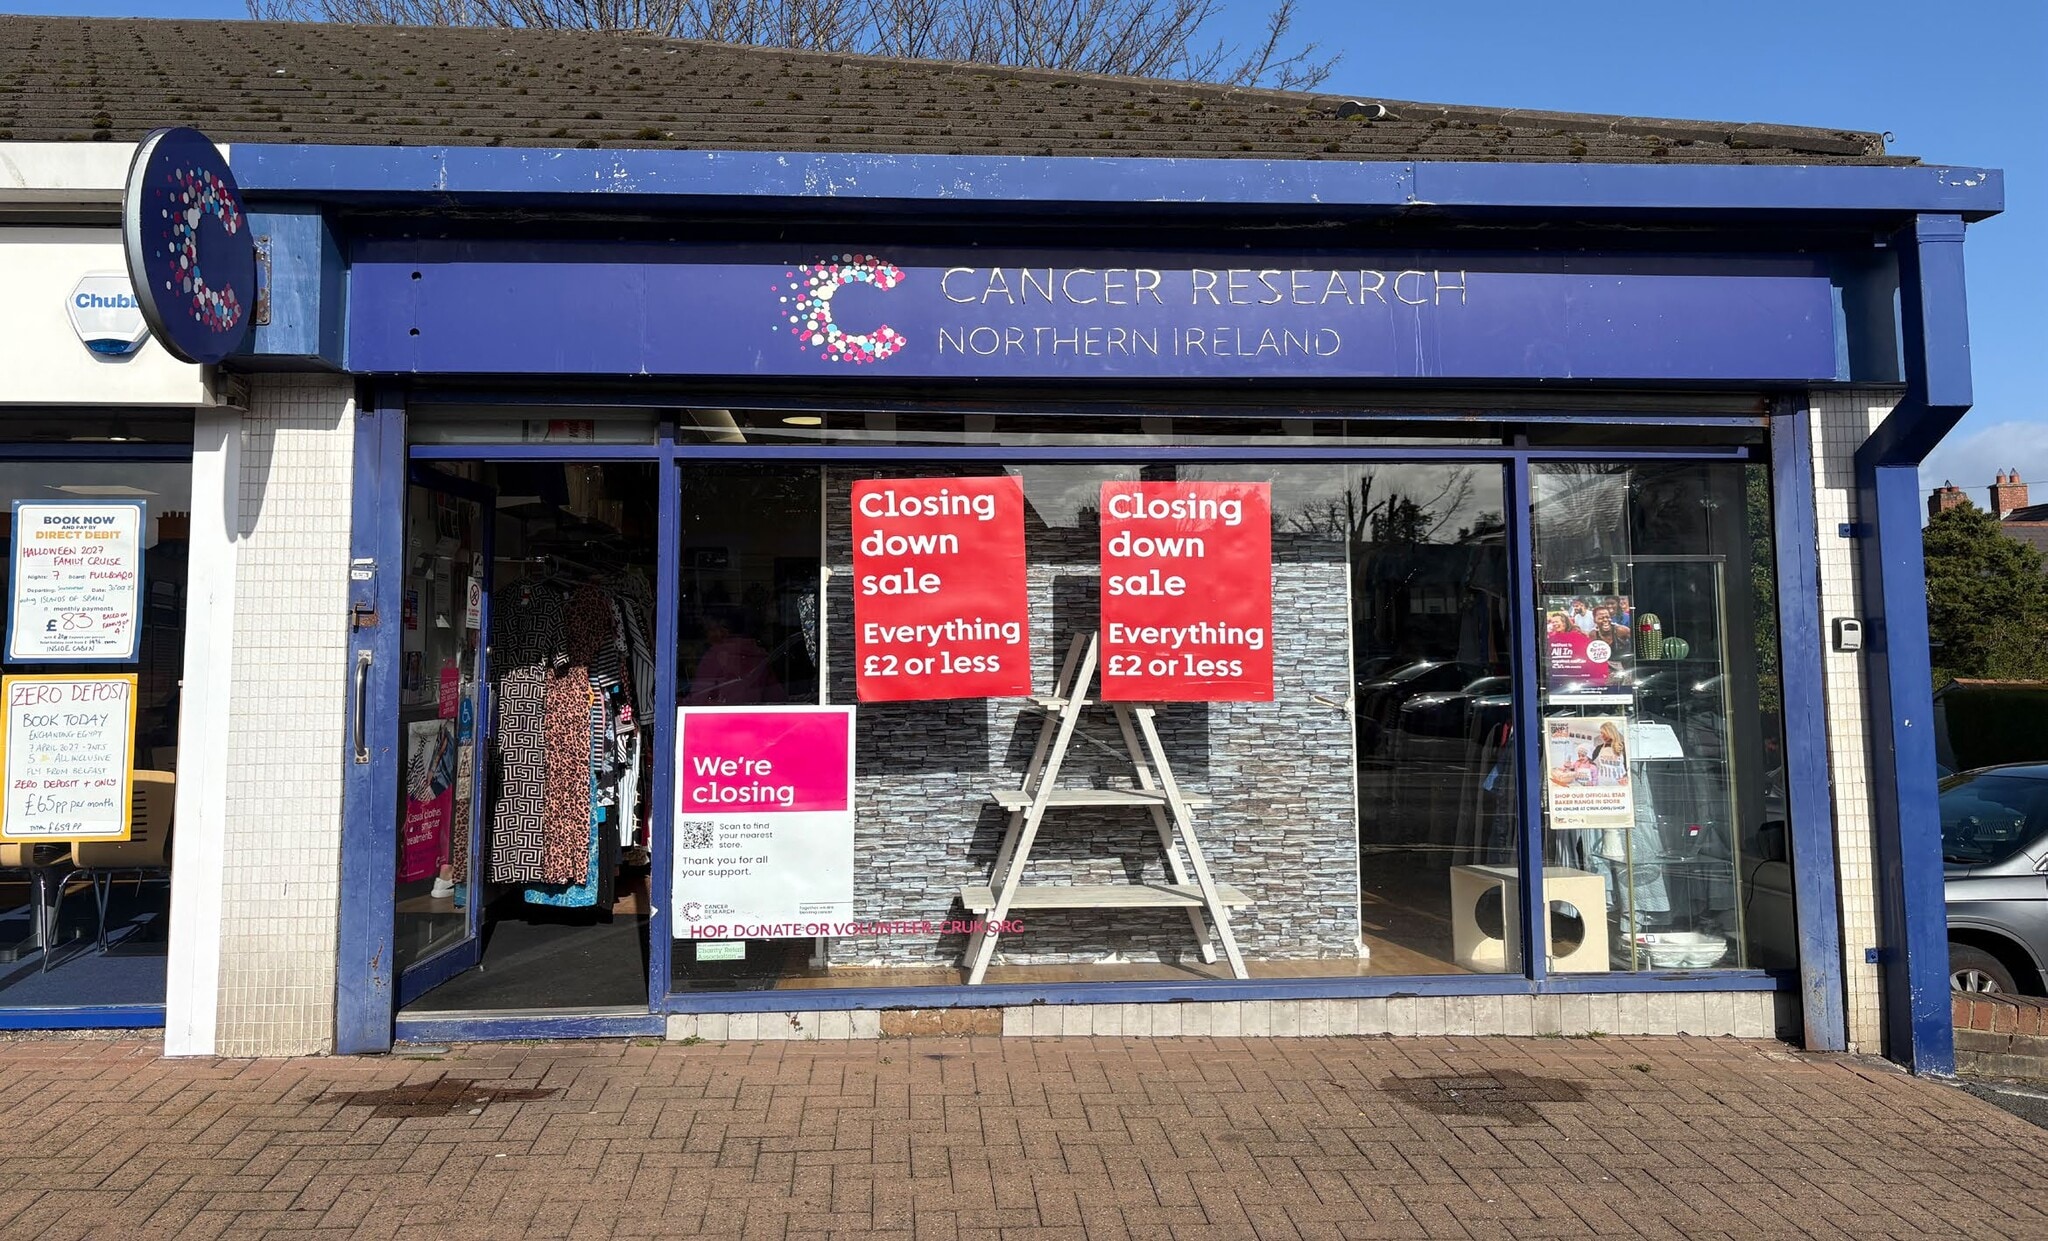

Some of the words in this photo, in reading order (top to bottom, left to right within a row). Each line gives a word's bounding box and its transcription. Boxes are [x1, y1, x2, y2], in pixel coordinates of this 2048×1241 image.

[940, 267, 1164, 305] CANCER
[1191, 268, 1467, 306] RESEARCH
[939, 327, 1158, 356] NORTHERN
[1174, 327, 1341, 357] IRELAND
[859, 489, 996, 522] Closing
[1108, 487, 1243, 527] Closing
[43, 516, 80, 525] BOOK
[83, 516, 116, 525] NOW
[35, 531, 82, 540] DIRECT
[84, 531, 121, 539] DEBIT
[860, 529, 959, 557] down
[1108, 530, 1205, 558] down
[22, 546, 76, 558] HALLOWEEN
[81, 545, 104, 555] 2027
[53, 556, 83, 566] FAMILY
[87, 557, 121, 566] CRUISE
[52, 571, 60, 581] 7
[861, 567, 942, 596] sale
[1108, 569, 1188, 597] sale
[82, 595, 105, 603] SPAIN
[53, 605, 81, 613] monthly
[863, 617, 1021, 648] Everything
[1109, 622, 1265, 651] Everything
[1551, 648, 1562, 656] All
[1562, 647, 1573, 656] In
[863, 655, 899, 677] £2
[904, 656, 936, 675] or
[940, 651, 1001, 675] less
[1108, 654, 1143, 677] £2
[1149, 658, 1179, 677] or
[1183, 654, 1243, 677] less
[12, 685, 63, 706] ZERO
[72, 682, 130, 701] DEPOSIT
[23, 713, 60, 728] BOOK
[63, 713, 109, 727] TODAY
[36, 743, 58, 752] APRIL
[46, 767, 68, 775] FROM
[14, 779, 38, 789] ZERO
[43, 779, 79, 789] DEPOSIT
[94, 778, 117, 788] ONLY
[692, 781, 795, 807] closing
[87, 798, 114, 809] month
[408, 812, 424, 824] Casual
[718, 823, 741, 831] Scan
[742, 823, 752, 831] to
[753, 822, 770, 831] find
[718, 832, 738, 840] your
[740, 831, 773, 839] nearest
[718, 841, 743, 849] store.
[683, 855, 714, 866] Thank
[717, 857, 737, 868] you
[738, 855, 753, 865] for
[755, 855, 769, 865] all
[682, 867, 706, 878] your
[708, 865, 752, 878] support.
[734, 923, 802, 937] DONATE
[805, 922, 830, 936] OR
